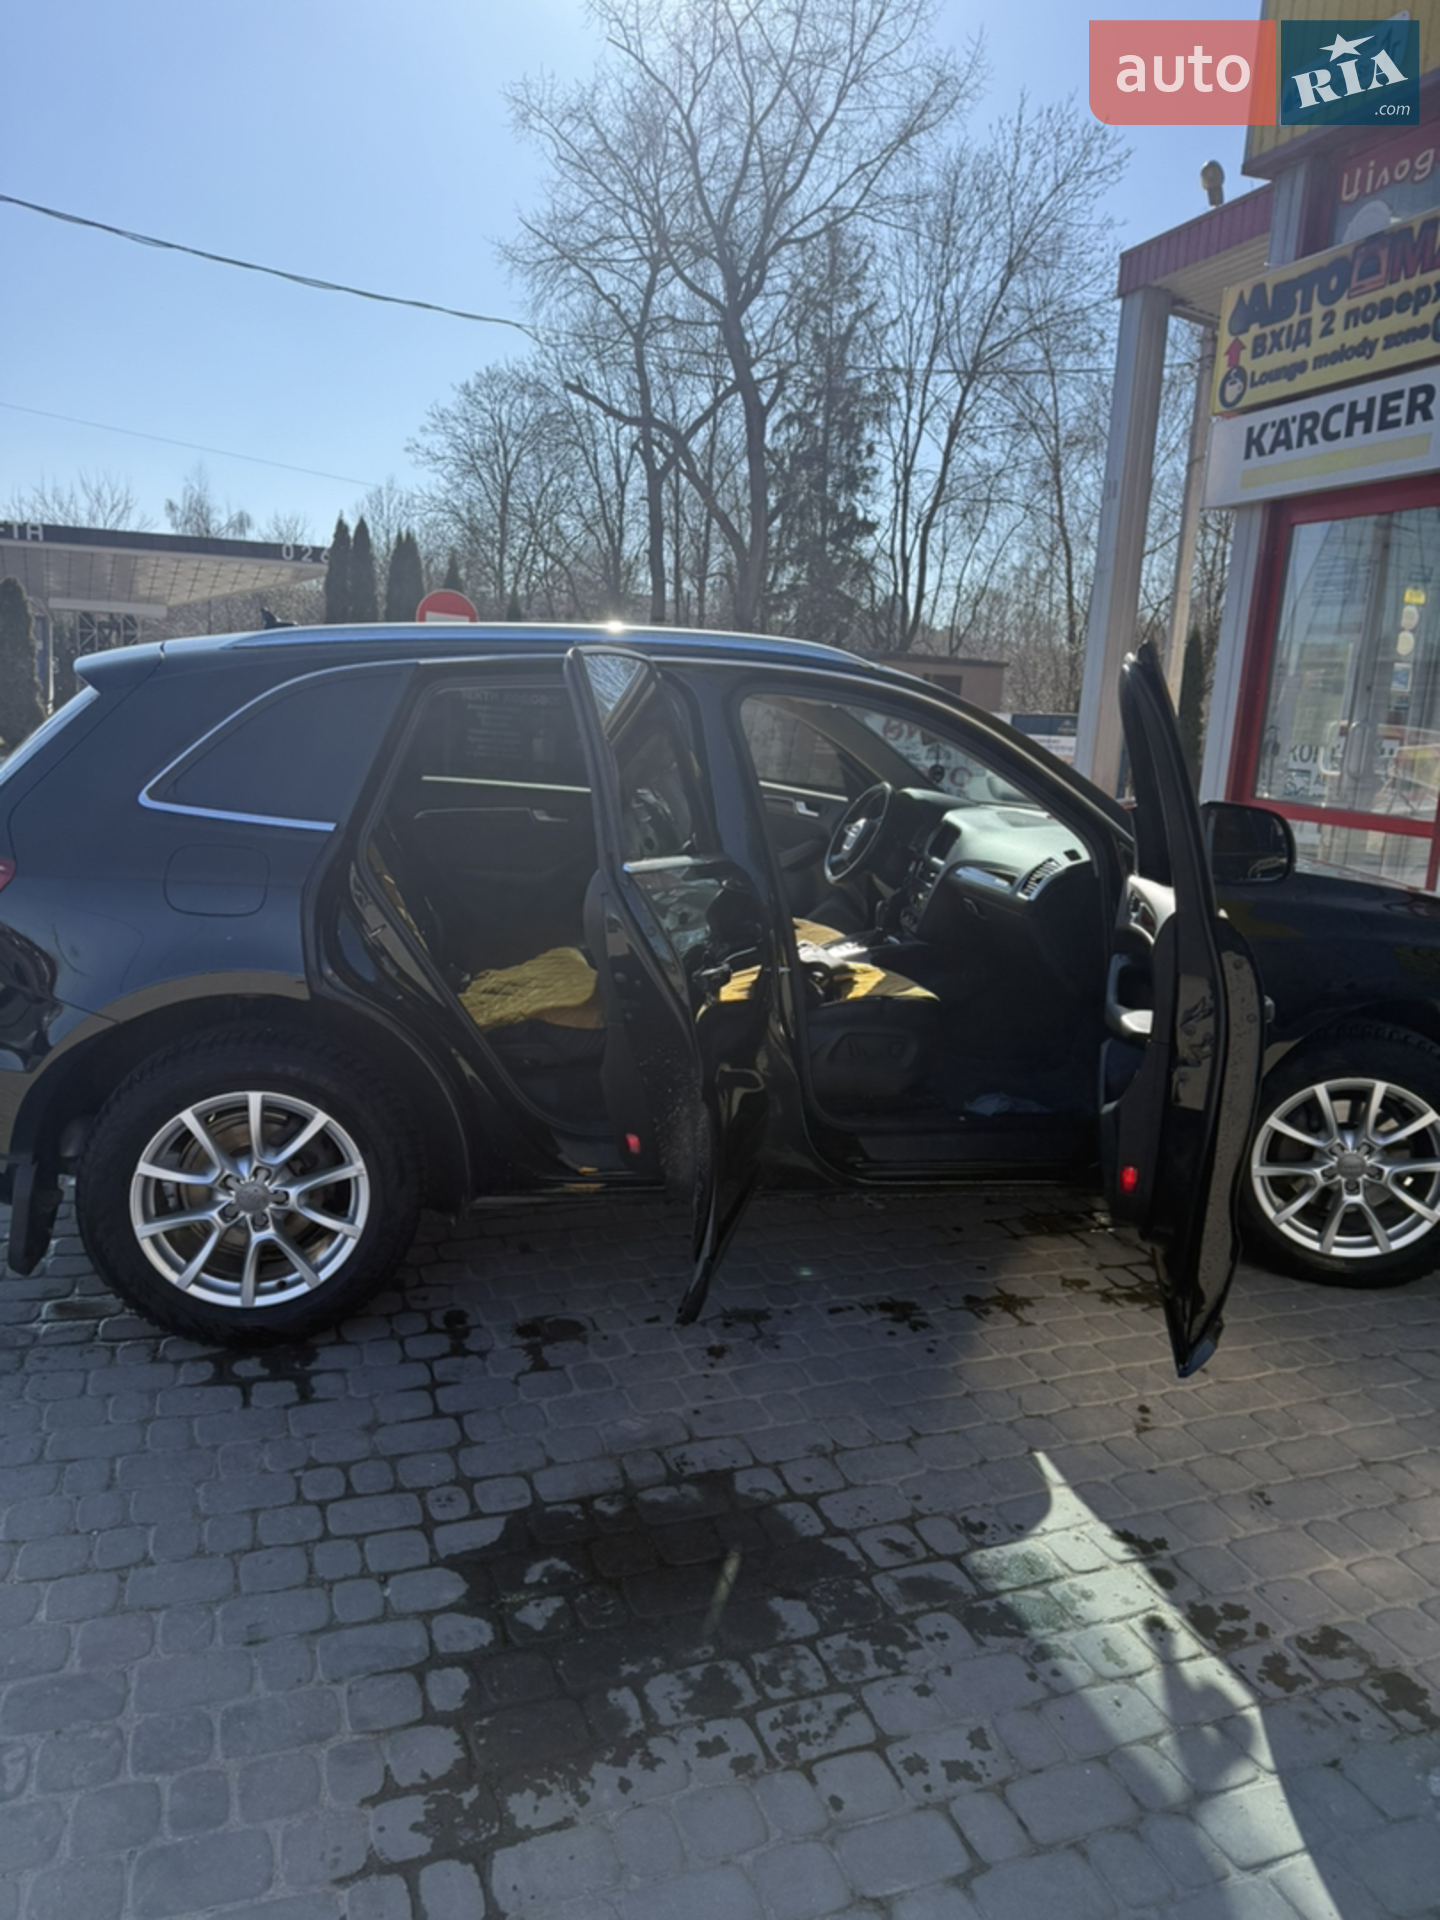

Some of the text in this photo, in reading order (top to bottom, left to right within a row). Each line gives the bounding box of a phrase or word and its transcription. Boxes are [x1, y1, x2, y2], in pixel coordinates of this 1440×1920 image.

[1250, 317, 1313, 361] ВХІД
[1318, 309, 1337, 339] 2
[1250, 322, 1431, 389] Lounge melody zone
[1243, 382, 1437, 461] KÄRCHER
